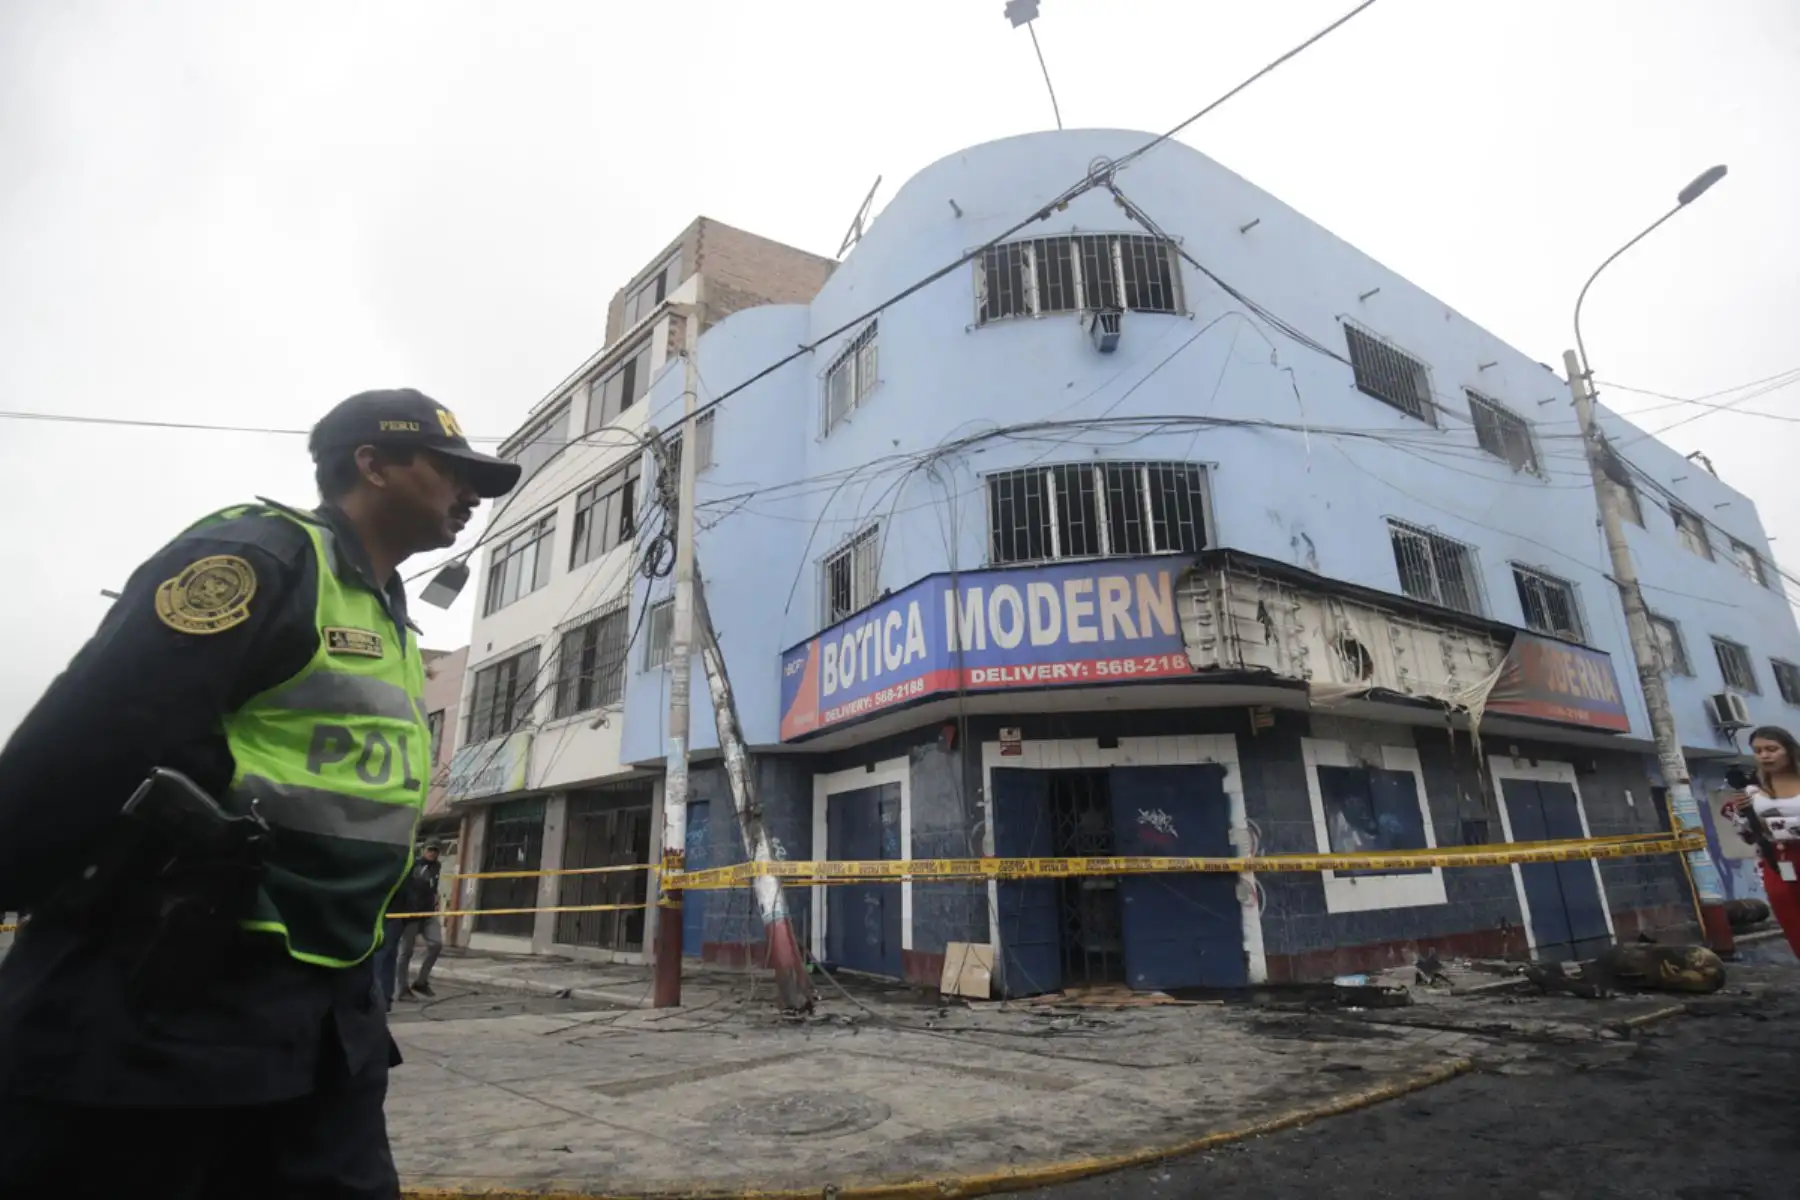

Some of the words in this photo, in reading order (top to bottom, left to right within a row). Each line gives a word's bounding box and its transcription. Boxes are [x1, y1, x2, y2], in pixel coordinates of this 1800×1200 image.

[380, 420, 420, 432] PERU
[822, 600, 927, 697] BOTICA
[944, 571, 1177, 653] MODERN
[971, 661, 1089, 684] DELIVERY:
[824, 696, 873, 722] DELIVERY:
[306, 722, 420, 793] POL
